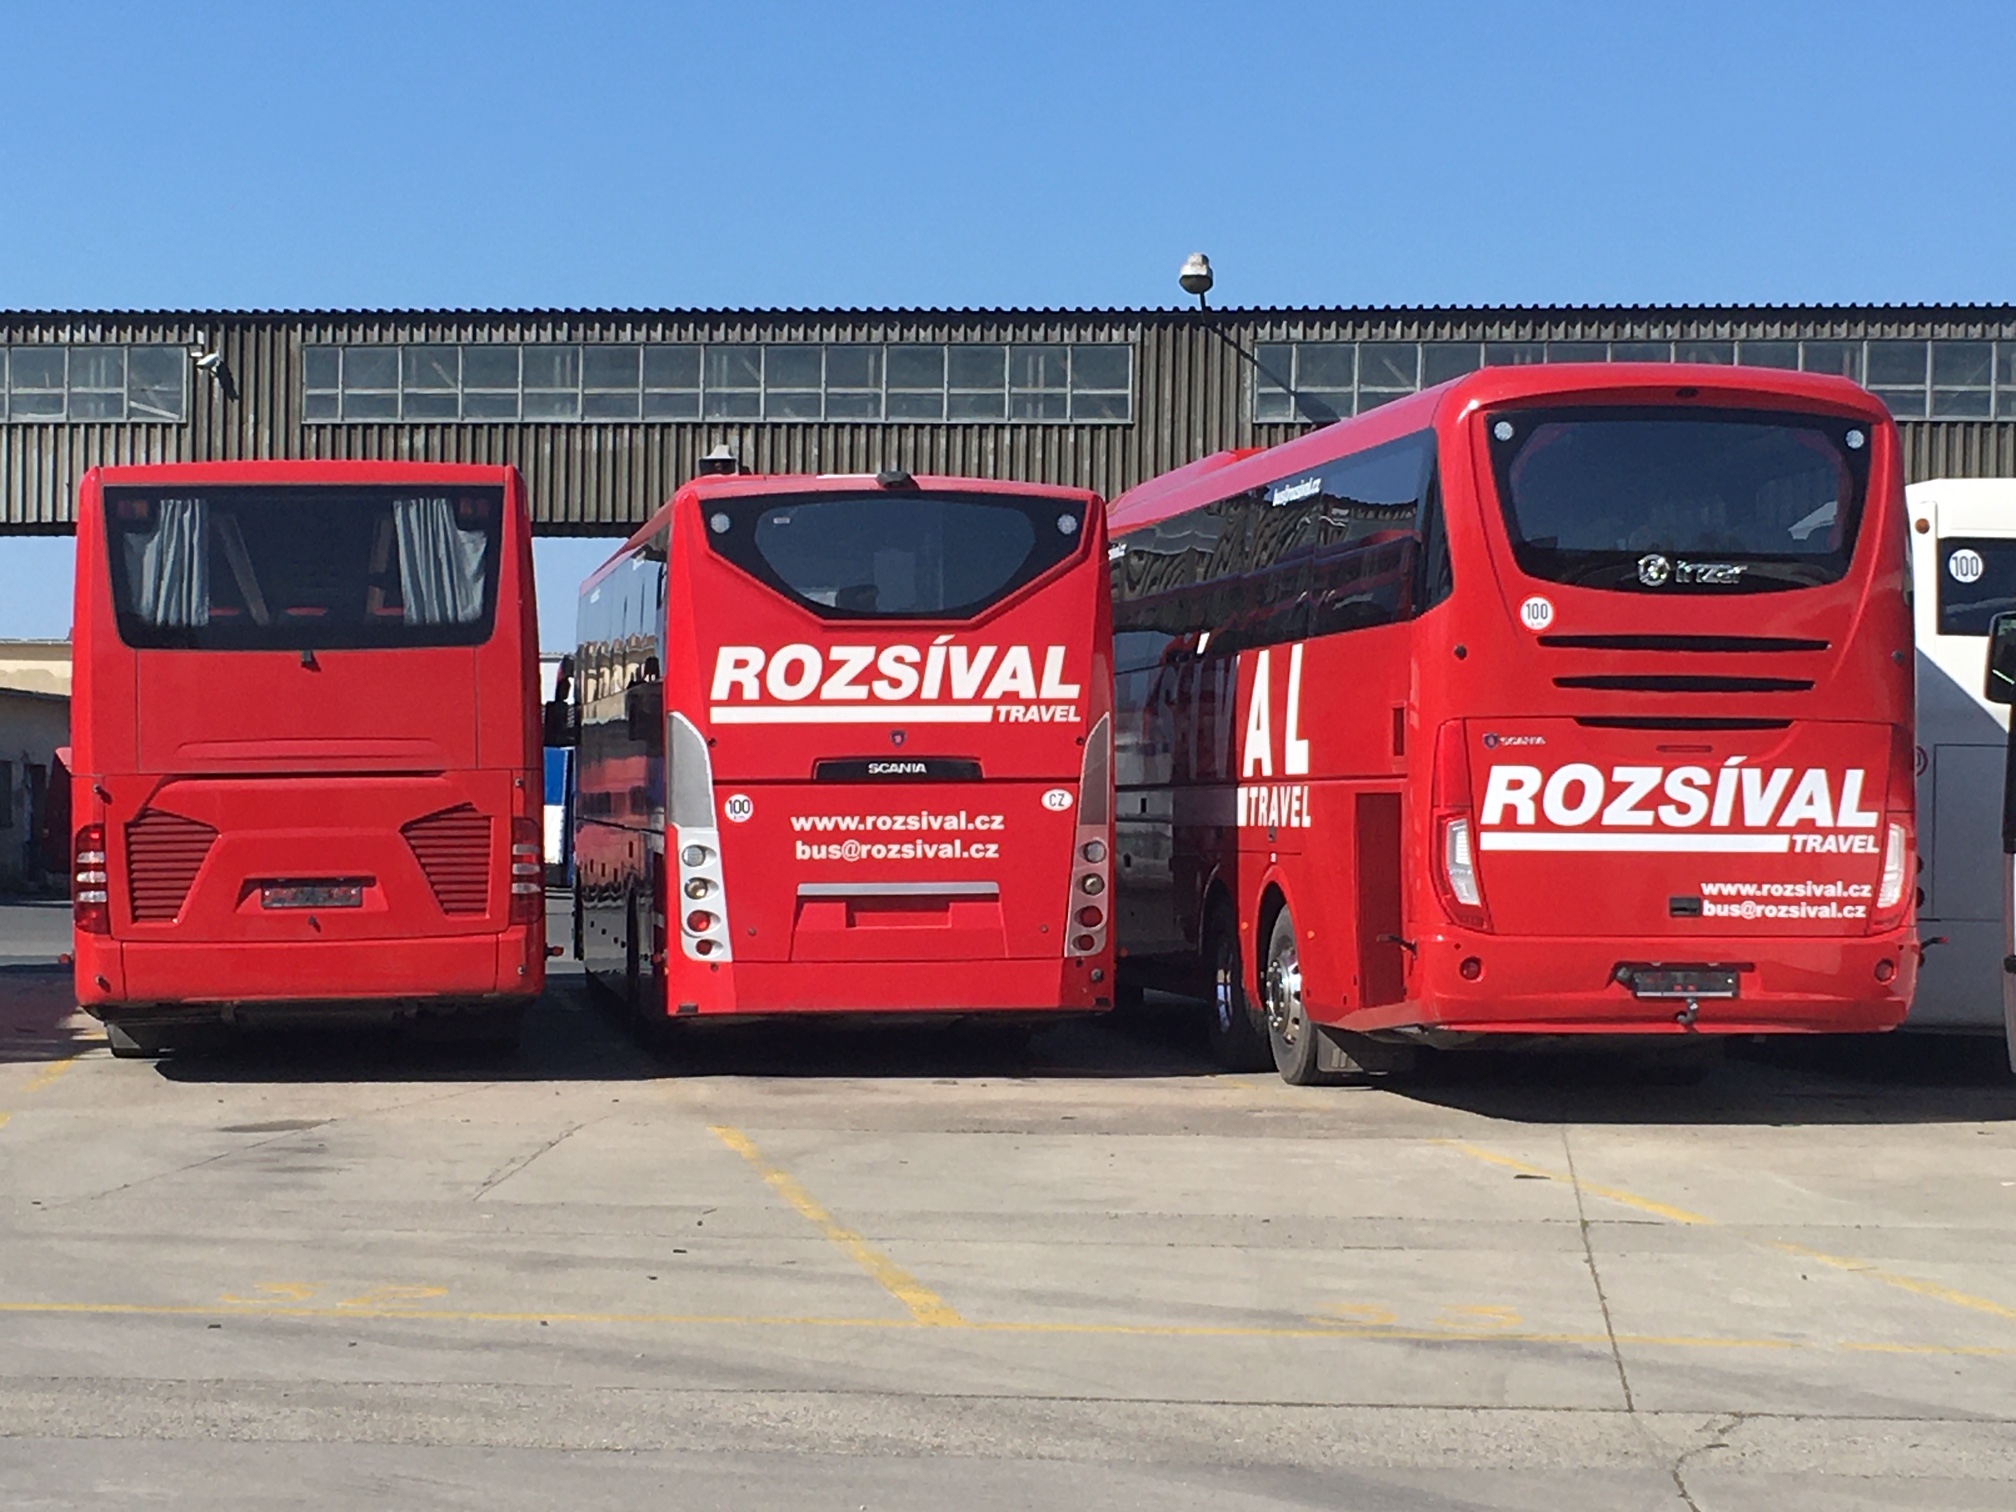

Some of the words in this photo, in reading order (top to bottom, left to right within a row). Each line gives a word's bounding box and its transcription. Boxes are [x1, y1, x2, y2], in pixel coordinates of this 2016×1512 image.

[1951, 555, 1979, 577] 100
[1525, 602, 1549, 620] 100
[709, 634, 1081, 702] ROZSÍVAL
[996, 703, 1081, 723] TRAVEL
[868, 762, 927, 774] SCANIA
[1048, 792, 1065, 807] CZ
[1480, 755, 1879, 828] ROZSÍVAL
[728, 798, 751, 815] 100
[1249, 785, 1311, 828] TRAVEL
[790, 810, 1005, 832] www.rozsival.cz
[795, 838, 1000, 862] bus@rozsival.cz
[1791, 833, 1880, 854] TRAVEL
[1700, 880, 1873, 898] www.rozsival.cz
[1702, 899, 1867, 920] bus@rozsival.cz
